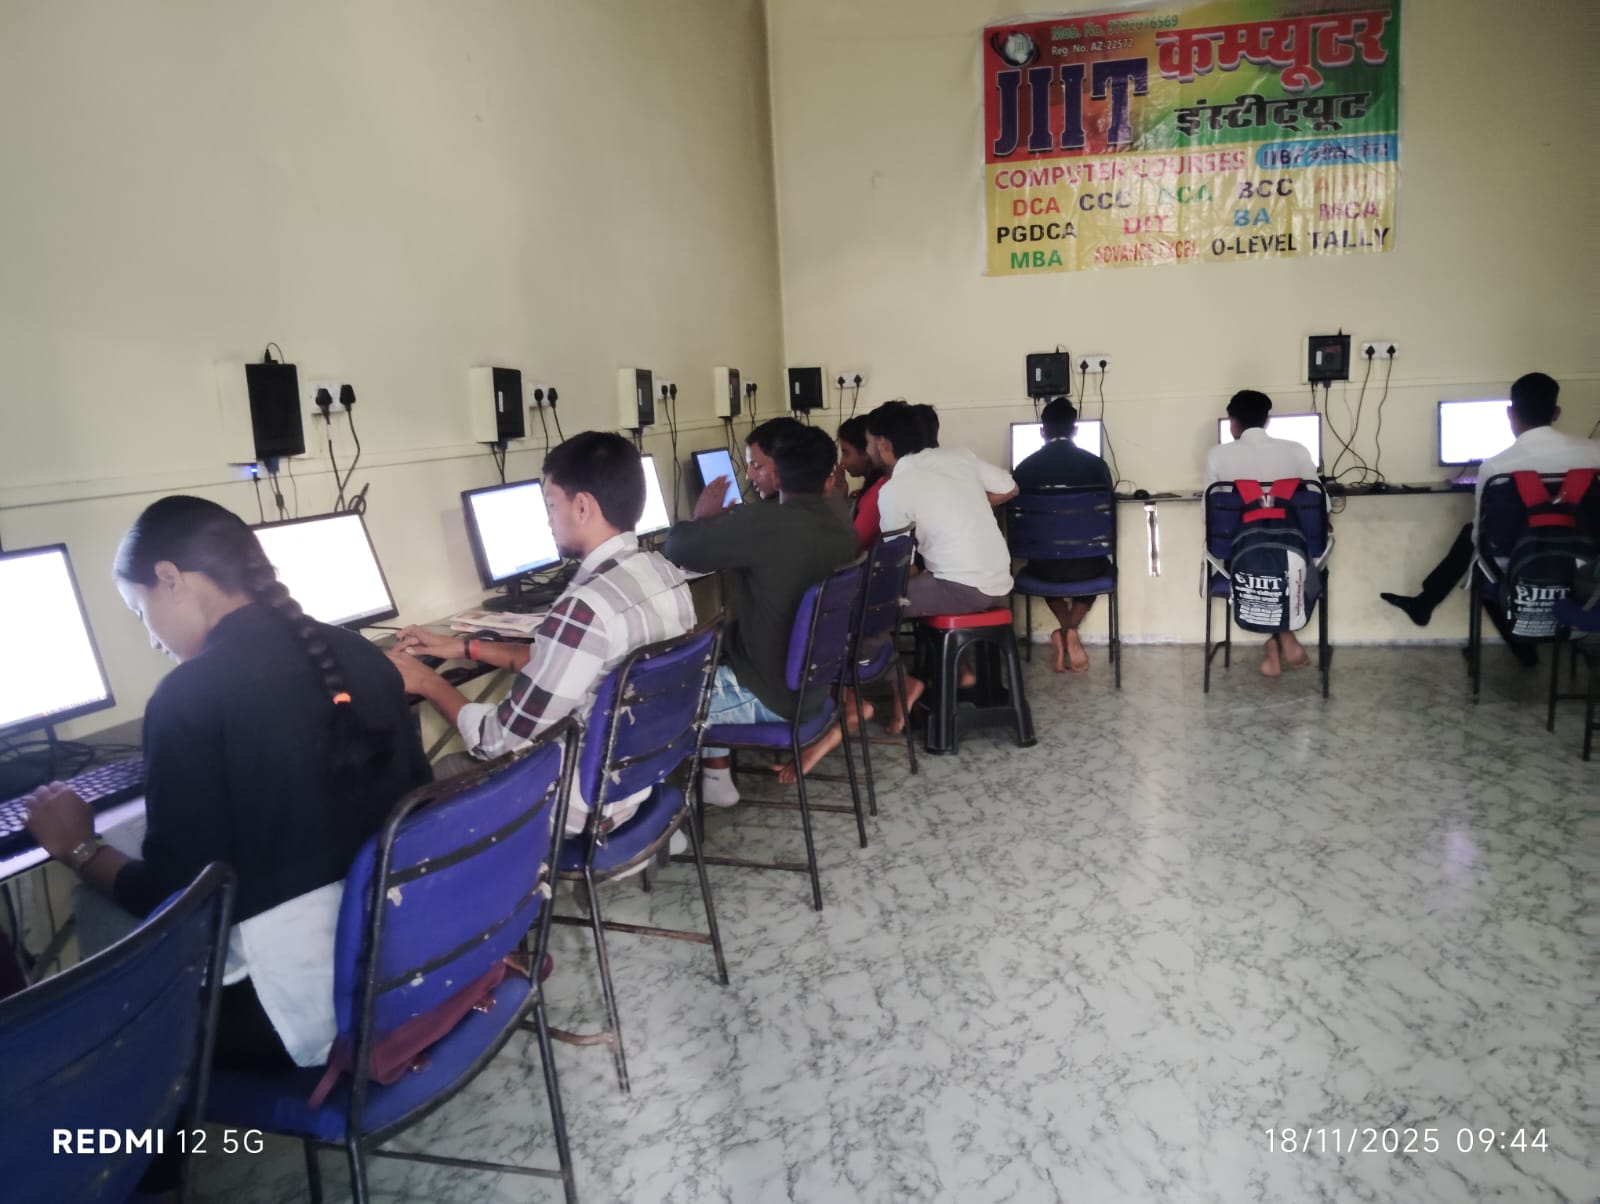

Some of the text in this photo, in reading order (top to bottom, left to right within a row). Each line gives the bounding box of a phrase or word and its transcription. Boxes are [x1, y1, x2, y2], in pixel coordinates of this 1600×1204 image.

[994, 57, 1149, 155] JIIT
[995, 151, 1246, 190] COMPUTER COURSES
[1238, 178, 1293, 199] BCC
[1013, 197, 1061, 216] DCA
[1079, 191, 1132, 211] CCC
[1233, 208, 1271, 226] BA
[997, 222, 1077, 243] PGDCA
[1308, 227, 1390, 250] TALLY
[1211, 233, 1297, 255] O-LEVEL
[1010, 250, 1063, 269] MBA
